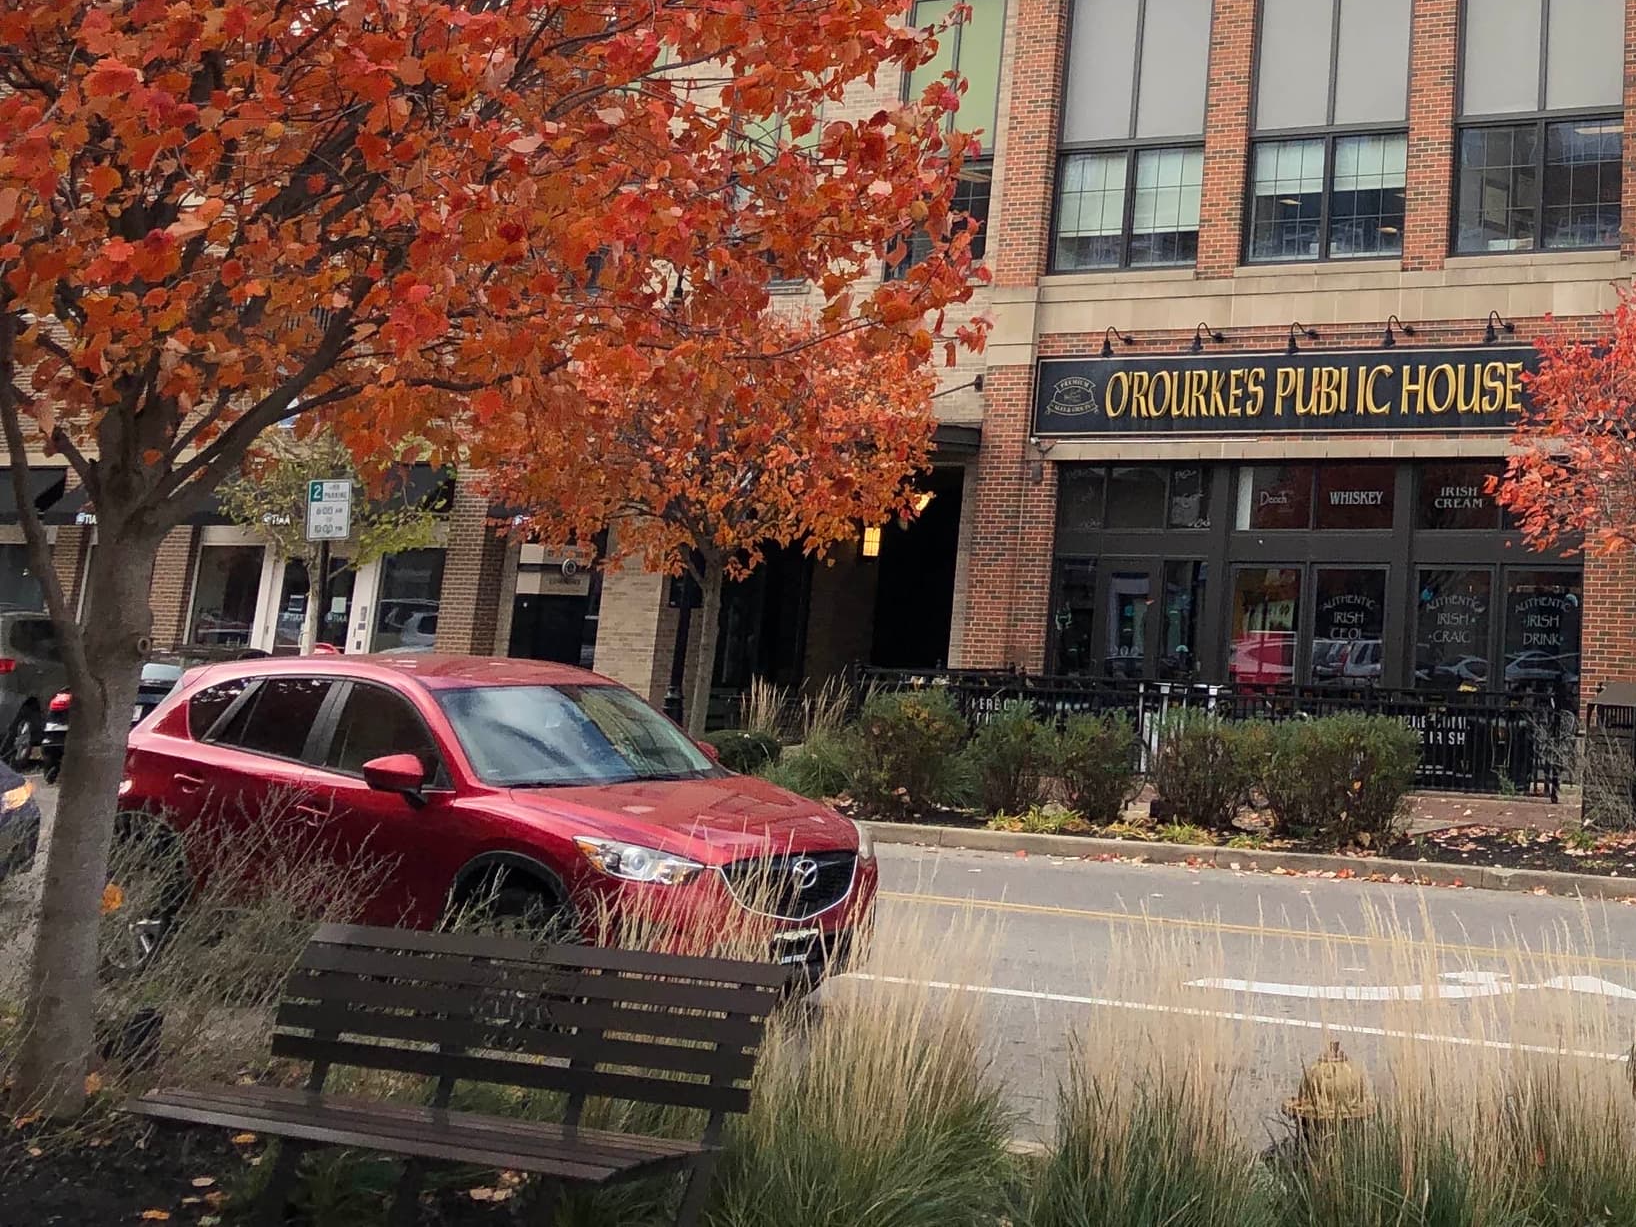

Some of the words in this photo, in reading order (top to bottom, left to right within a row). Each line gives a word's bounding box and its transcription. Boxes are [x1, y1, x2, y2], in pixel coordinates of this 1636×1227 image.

[1104, 366, 1266, 420] O'ROURKE'S
[1400, 361, 1524, 415] HOUSE
[313, 484, 322, 500] 2
[1329, 491, 1384, 505] WHISKEY
[1440, 486, 1479, 498] IRISH
[1434, 497, 1483, 509] CREAM
[1322, 594, 1376, 612] AUTHENTIC
[1514, 596, 1572, 614] AUTHENTIC
[1333, 611, 1365, 625] IRISH
[1436, 612, 1469, 626] IRISH
[1526, 614, 1560, 628] IRISH
[1432, 629, 1472, 644] CRAIC
[1522, 632, 1562, 646] DRINK
